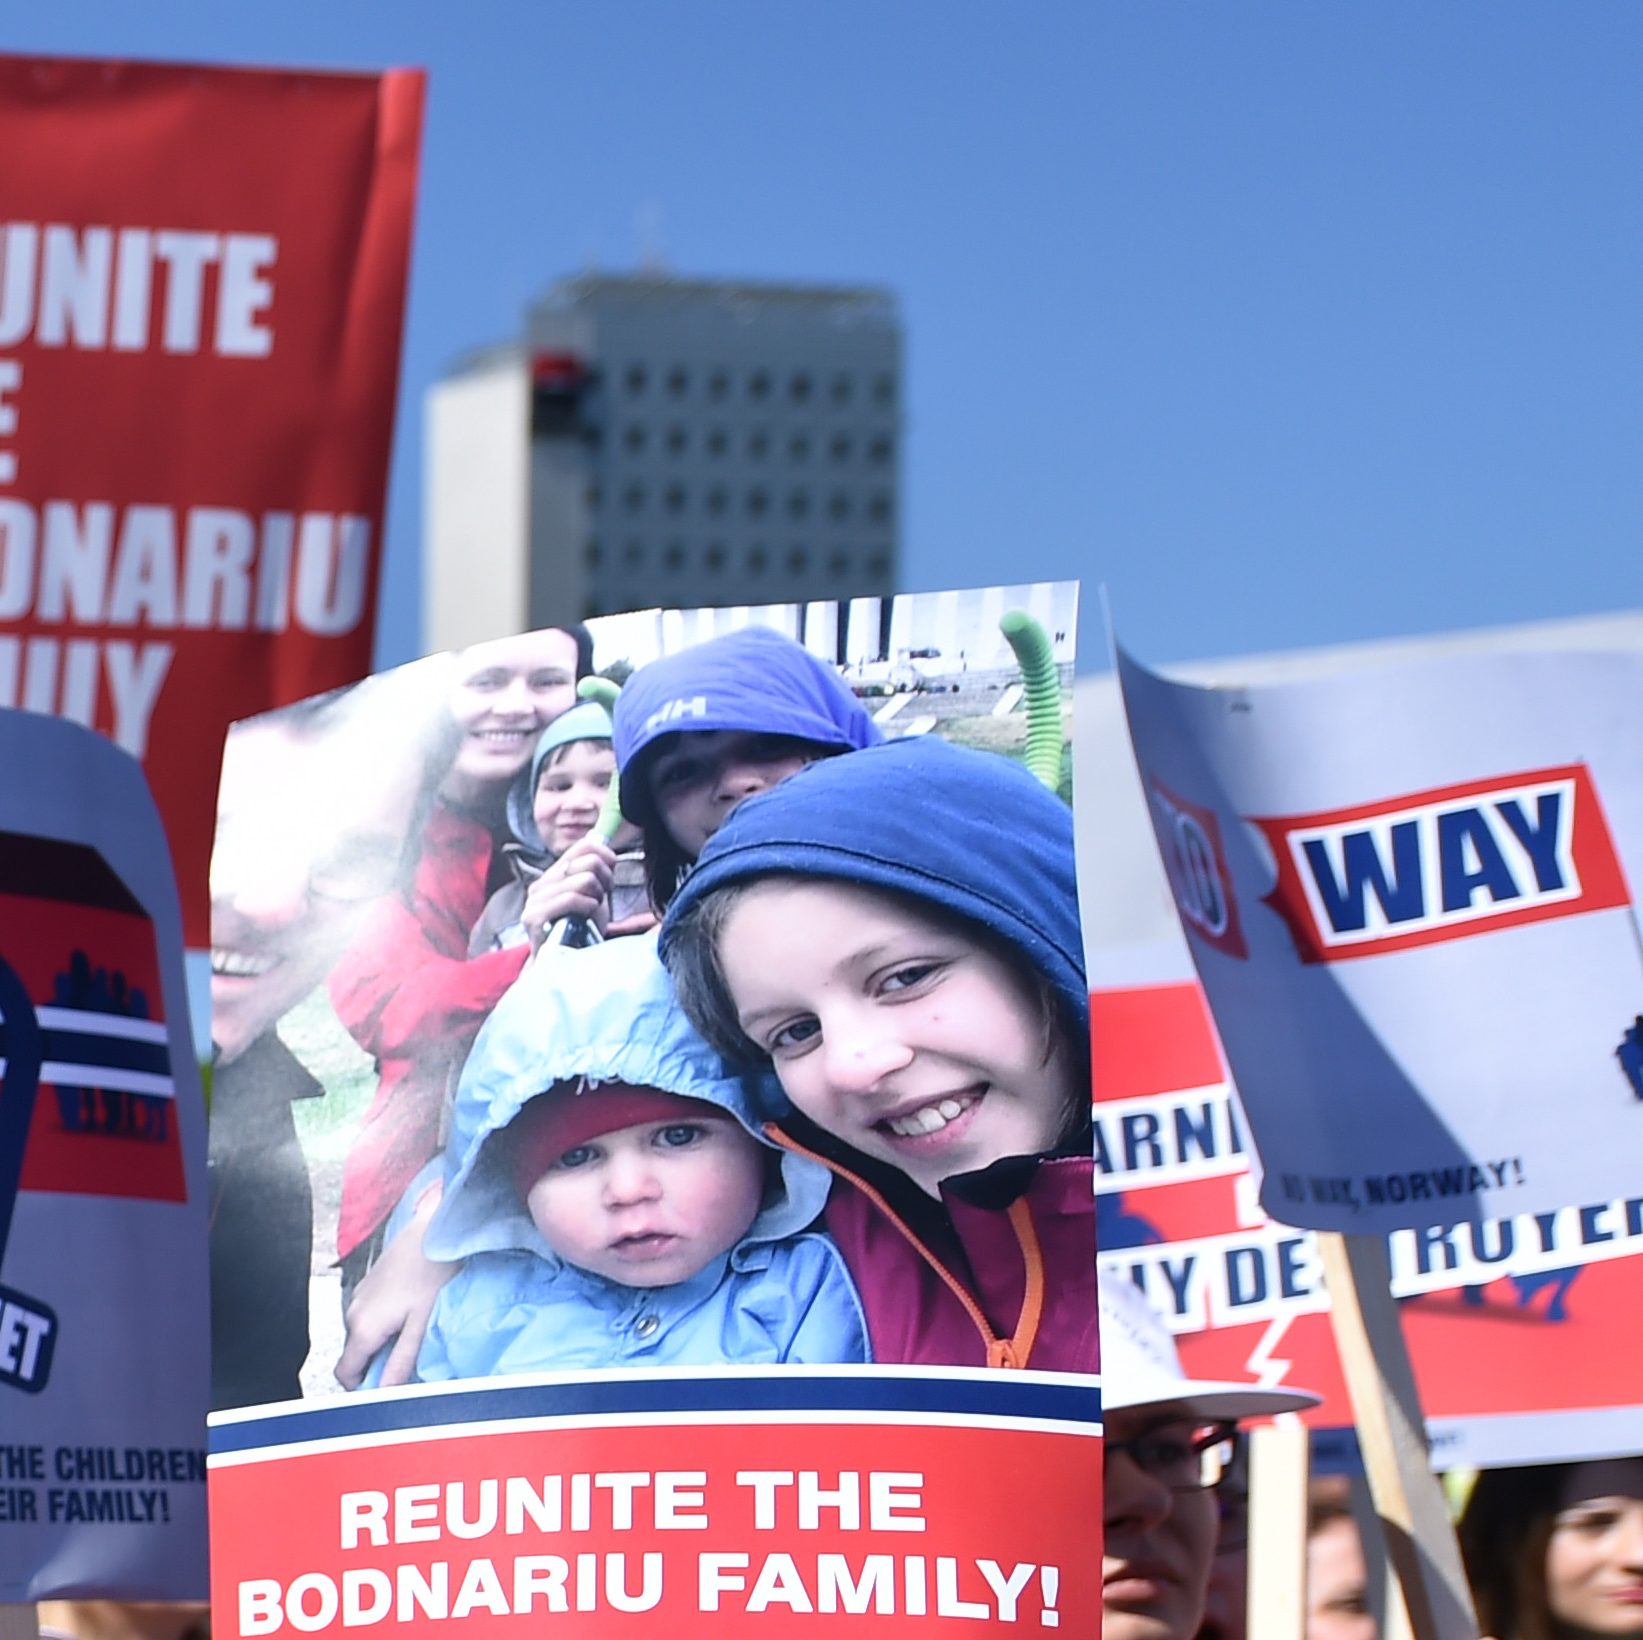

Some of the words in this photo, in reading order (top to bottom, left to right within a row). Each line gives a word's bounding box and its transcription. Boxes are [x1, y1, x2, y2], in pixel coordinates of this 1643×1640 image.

[1301, 791, 1566, 933] WAY
[1363, 1158, 1527, 1206] NORWAY!
[55, 1447, 209, 1484] CHILDREN
[48, 1488, 171, 1525] FAMILY!
[338, 1471, 710, 1549] REUNITE
[736, 1470, 928, 1532] THE
[237, 1552, 664, 1638] BODNARIU
[697, 1552, 1061, 1629] FAMILY!
